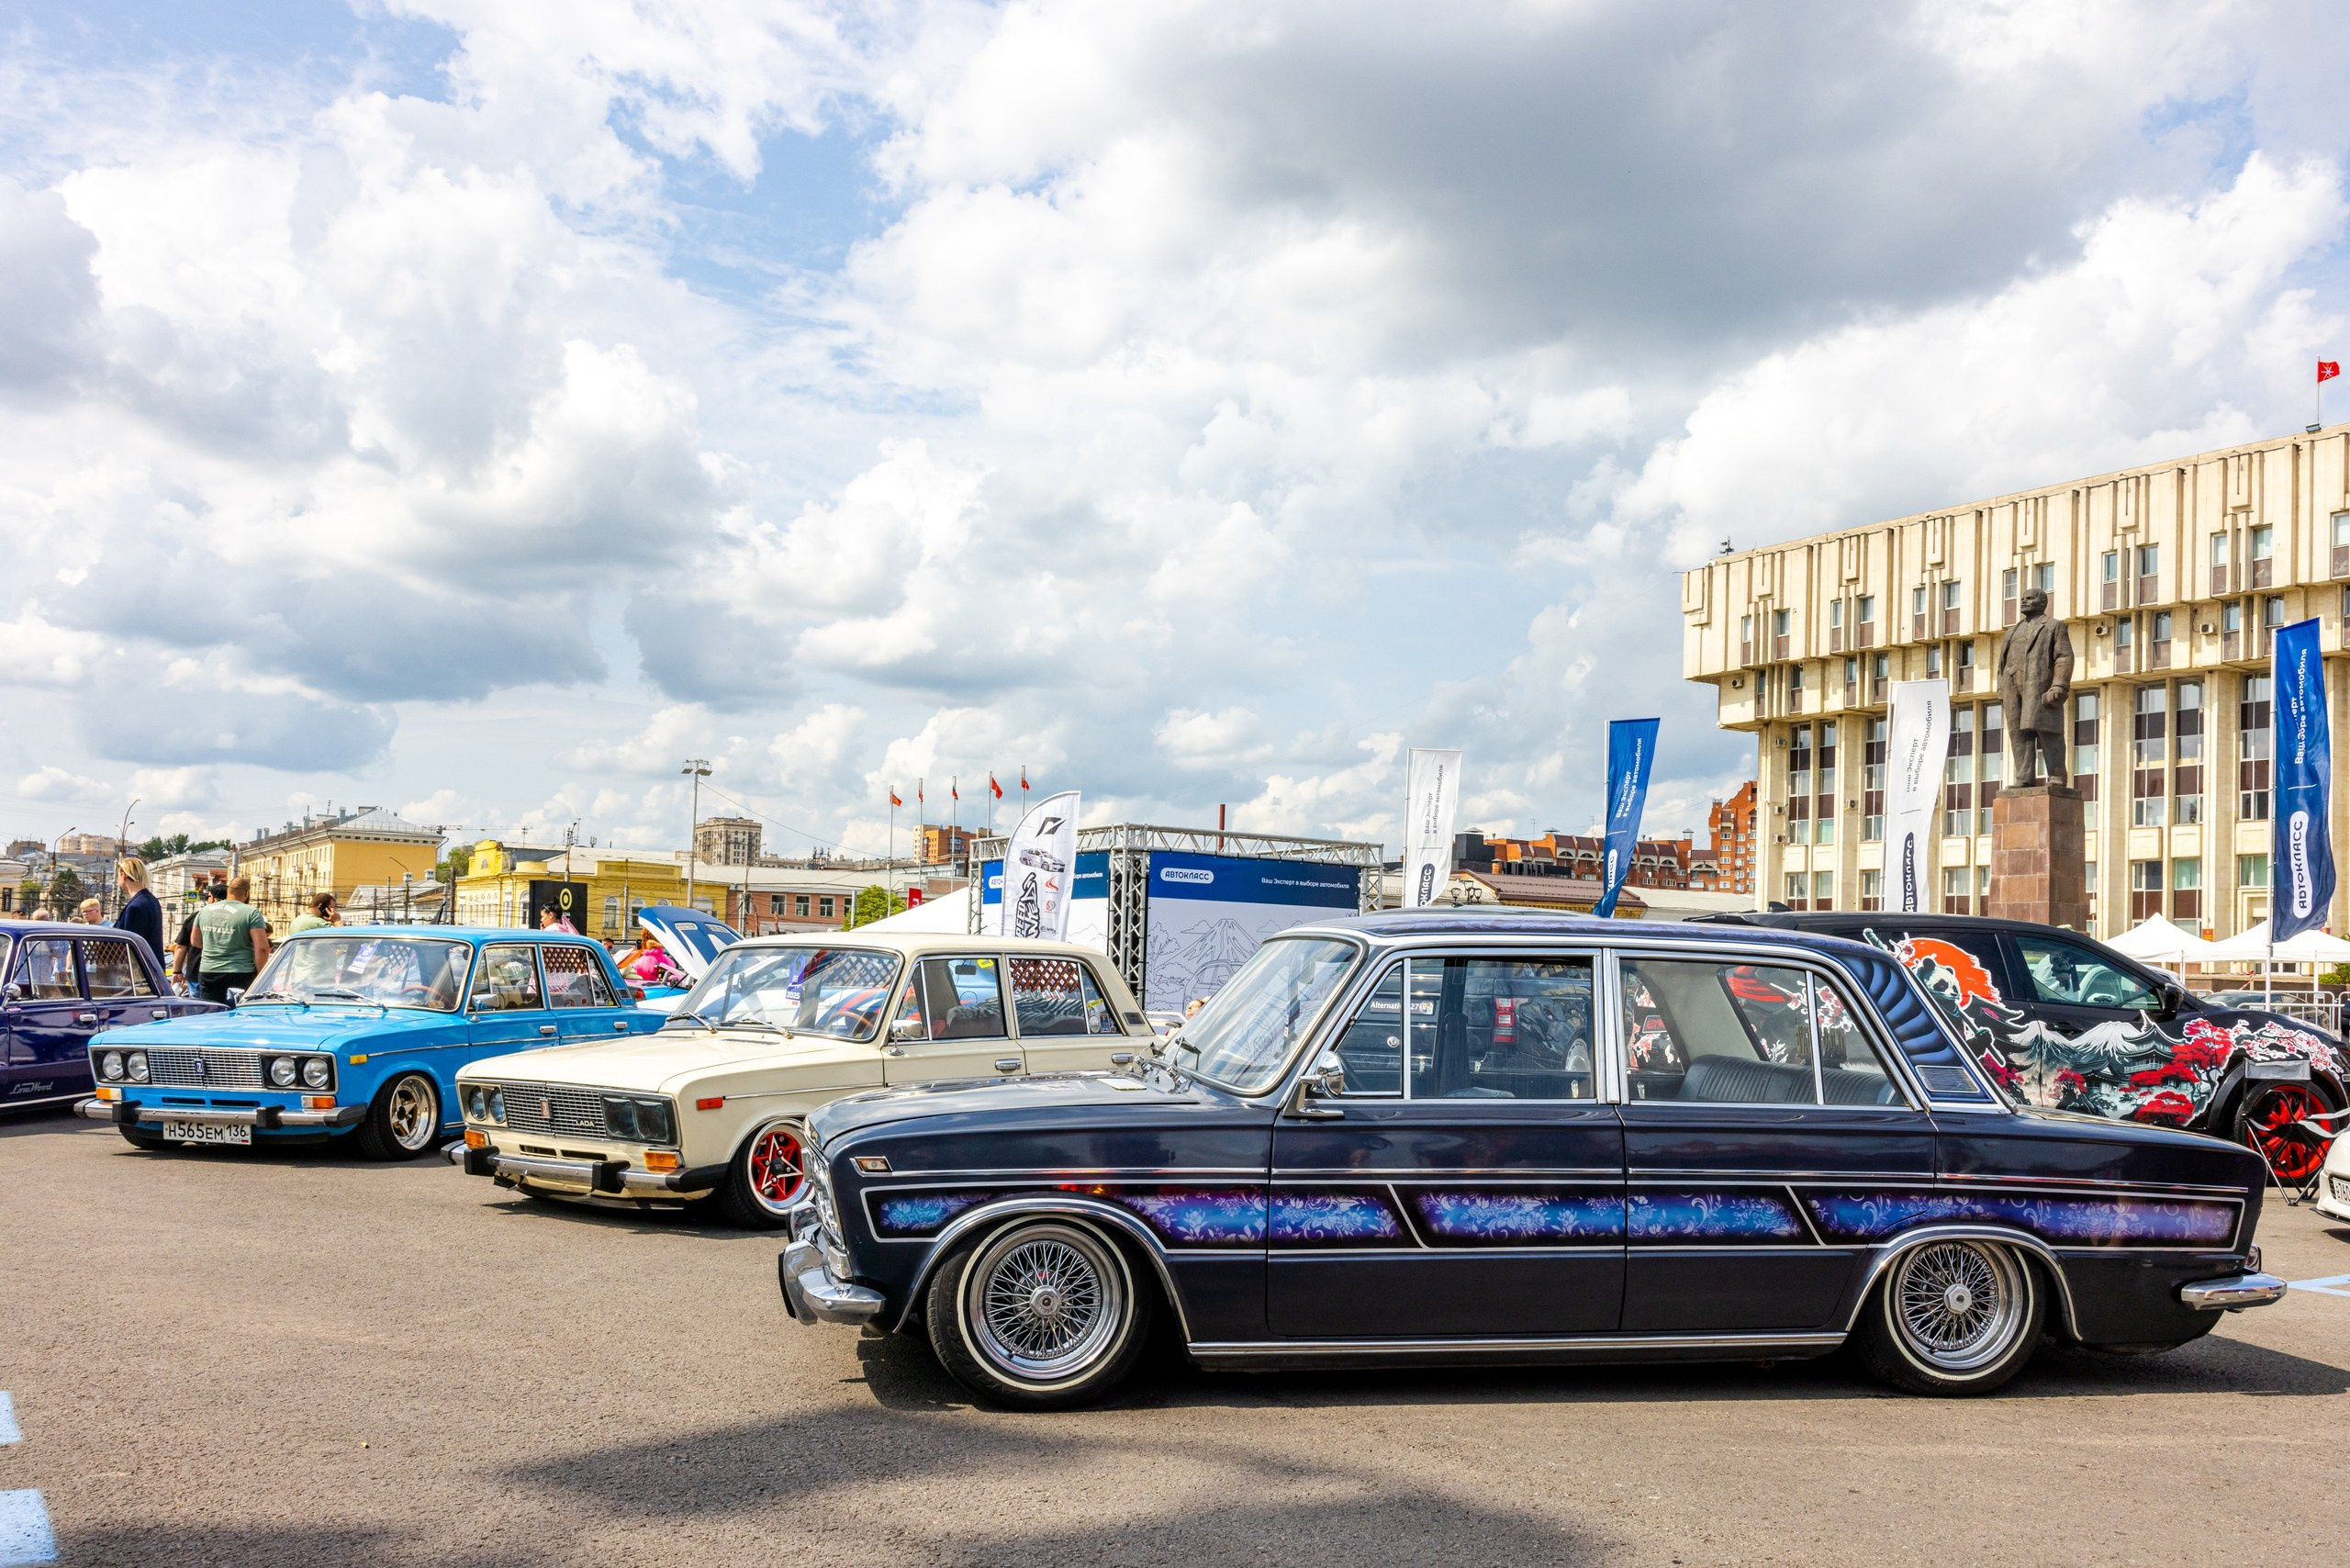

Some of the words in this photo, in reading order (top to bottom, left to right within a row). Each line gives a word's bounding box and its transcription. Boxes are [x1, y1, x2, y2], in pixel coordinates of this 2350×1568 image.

[1920, 700, 1931, 751] автомобиля
[1625, 785, 1637, 812] выборе
[1632, 738, 1642, 784] автомобиля
[1435, 765, 1443, 803] автомобиля
[1616, 801, 1624, 818] Ваш
[1621, 770, 1631, 801] Эксперт
[1165, 870, 1210, 880] АВТОКЛАСС
[1273, 878, 1295, 886] Эксперт
[1300, 879, 1319, 888] выборе
[786, 991, 800, 1000] 2025
[9, 1081, 54, 1094] LowWood
[225, 1124, 247, 1137] 136
